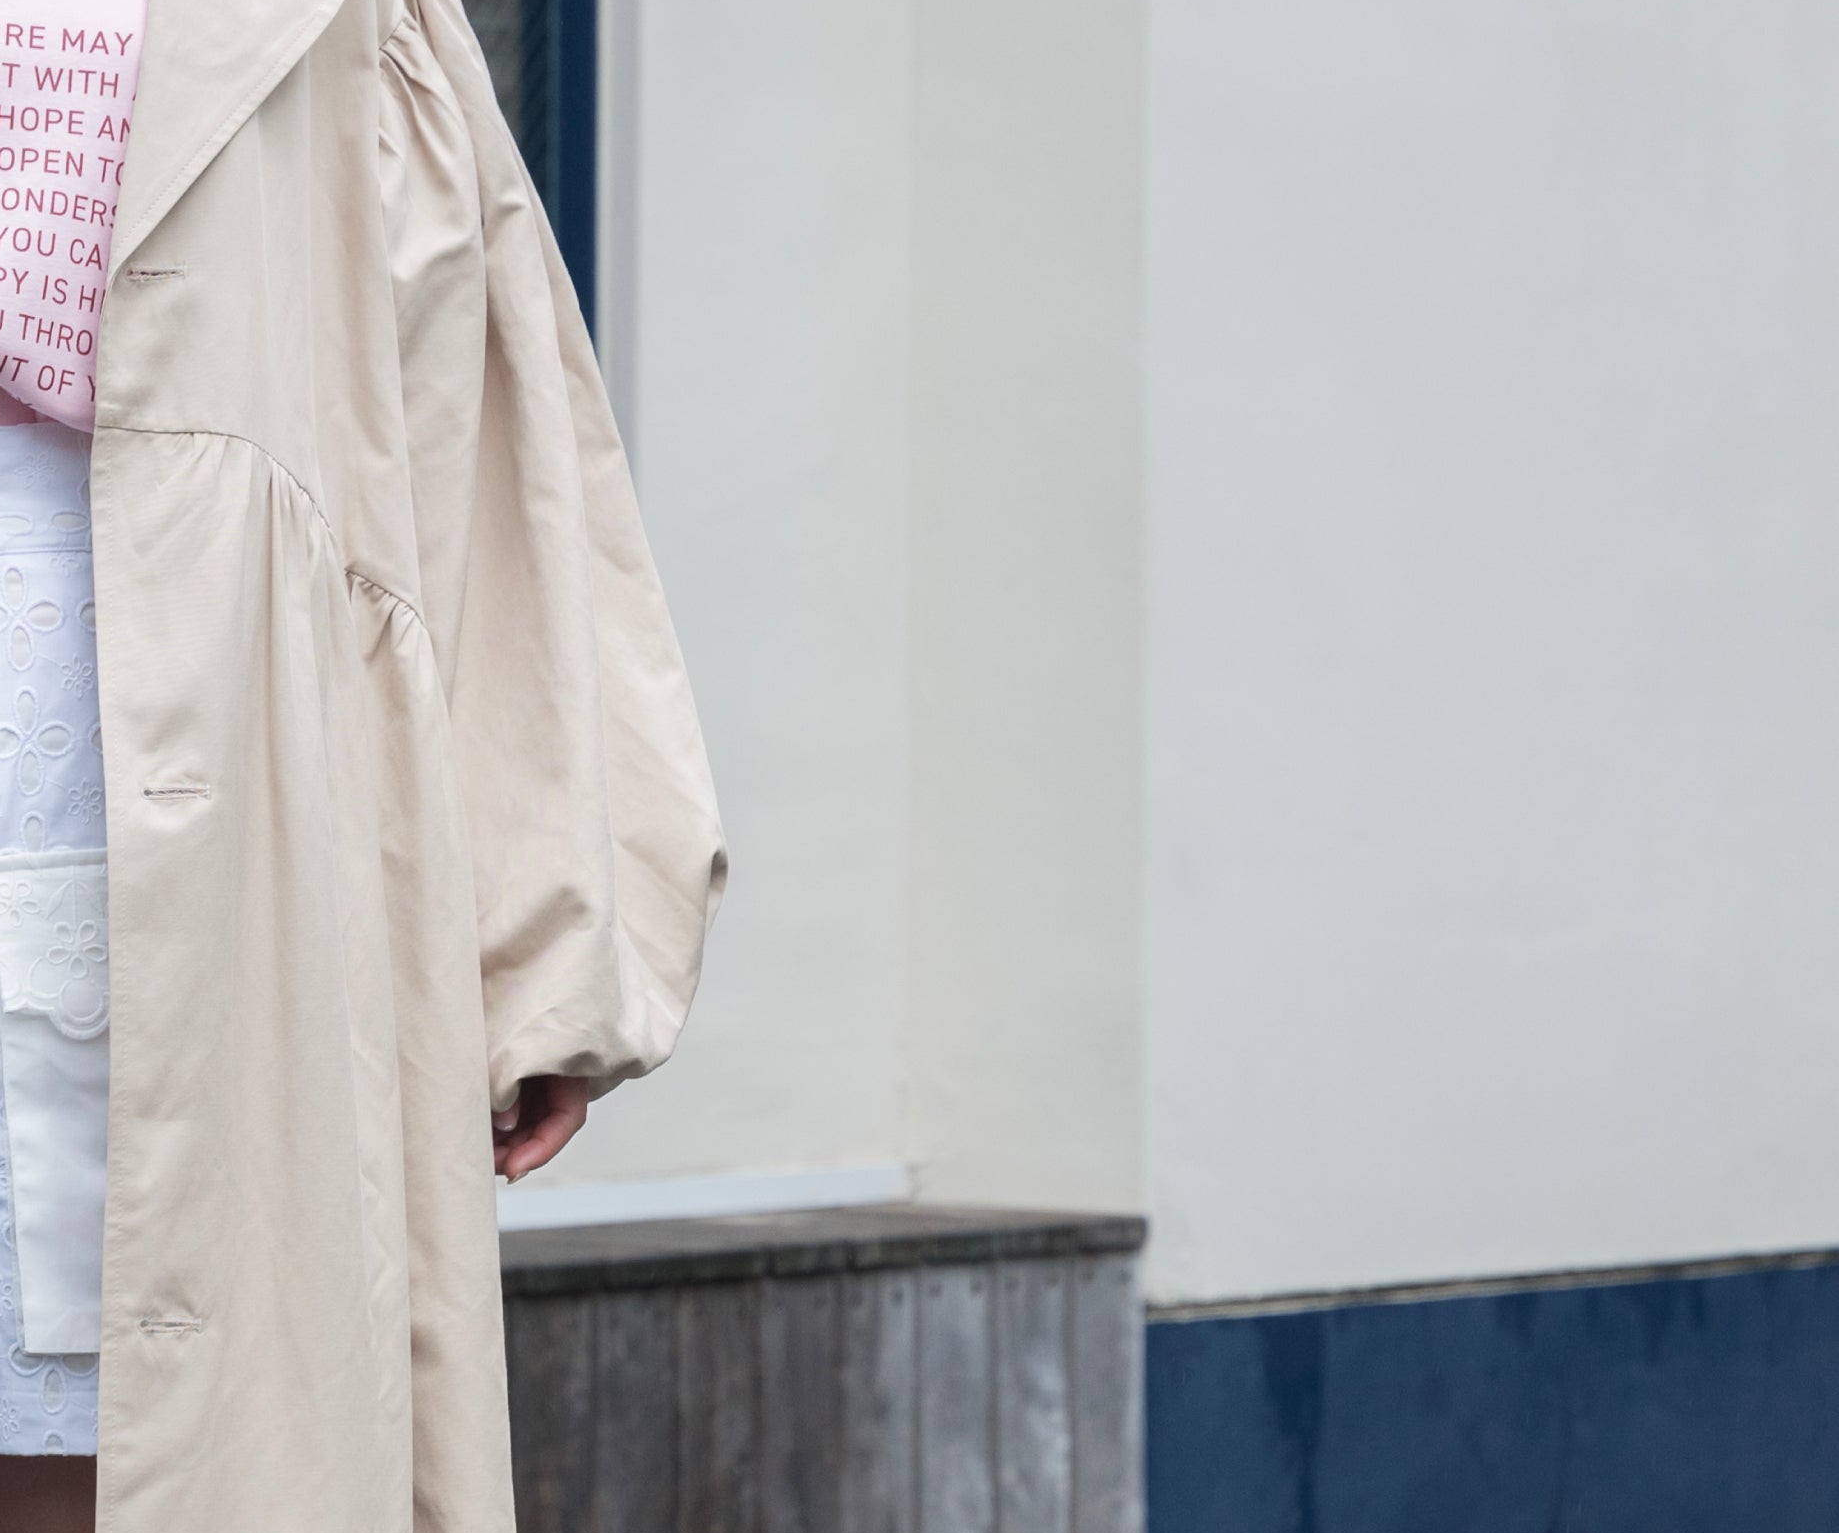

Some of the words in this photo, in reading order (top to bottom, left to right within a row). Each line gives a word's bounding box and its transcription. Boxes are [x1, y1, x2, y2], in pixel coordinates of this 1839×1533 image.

[62, 28, 133, 56] MAY
[34, 65, 119, 98] WITH
[42, 275, 68, 305] IS
[79, 284, 106, 315] H
[18, 313, 93, 356] THRO
[37, 365, 75, 395] OF
